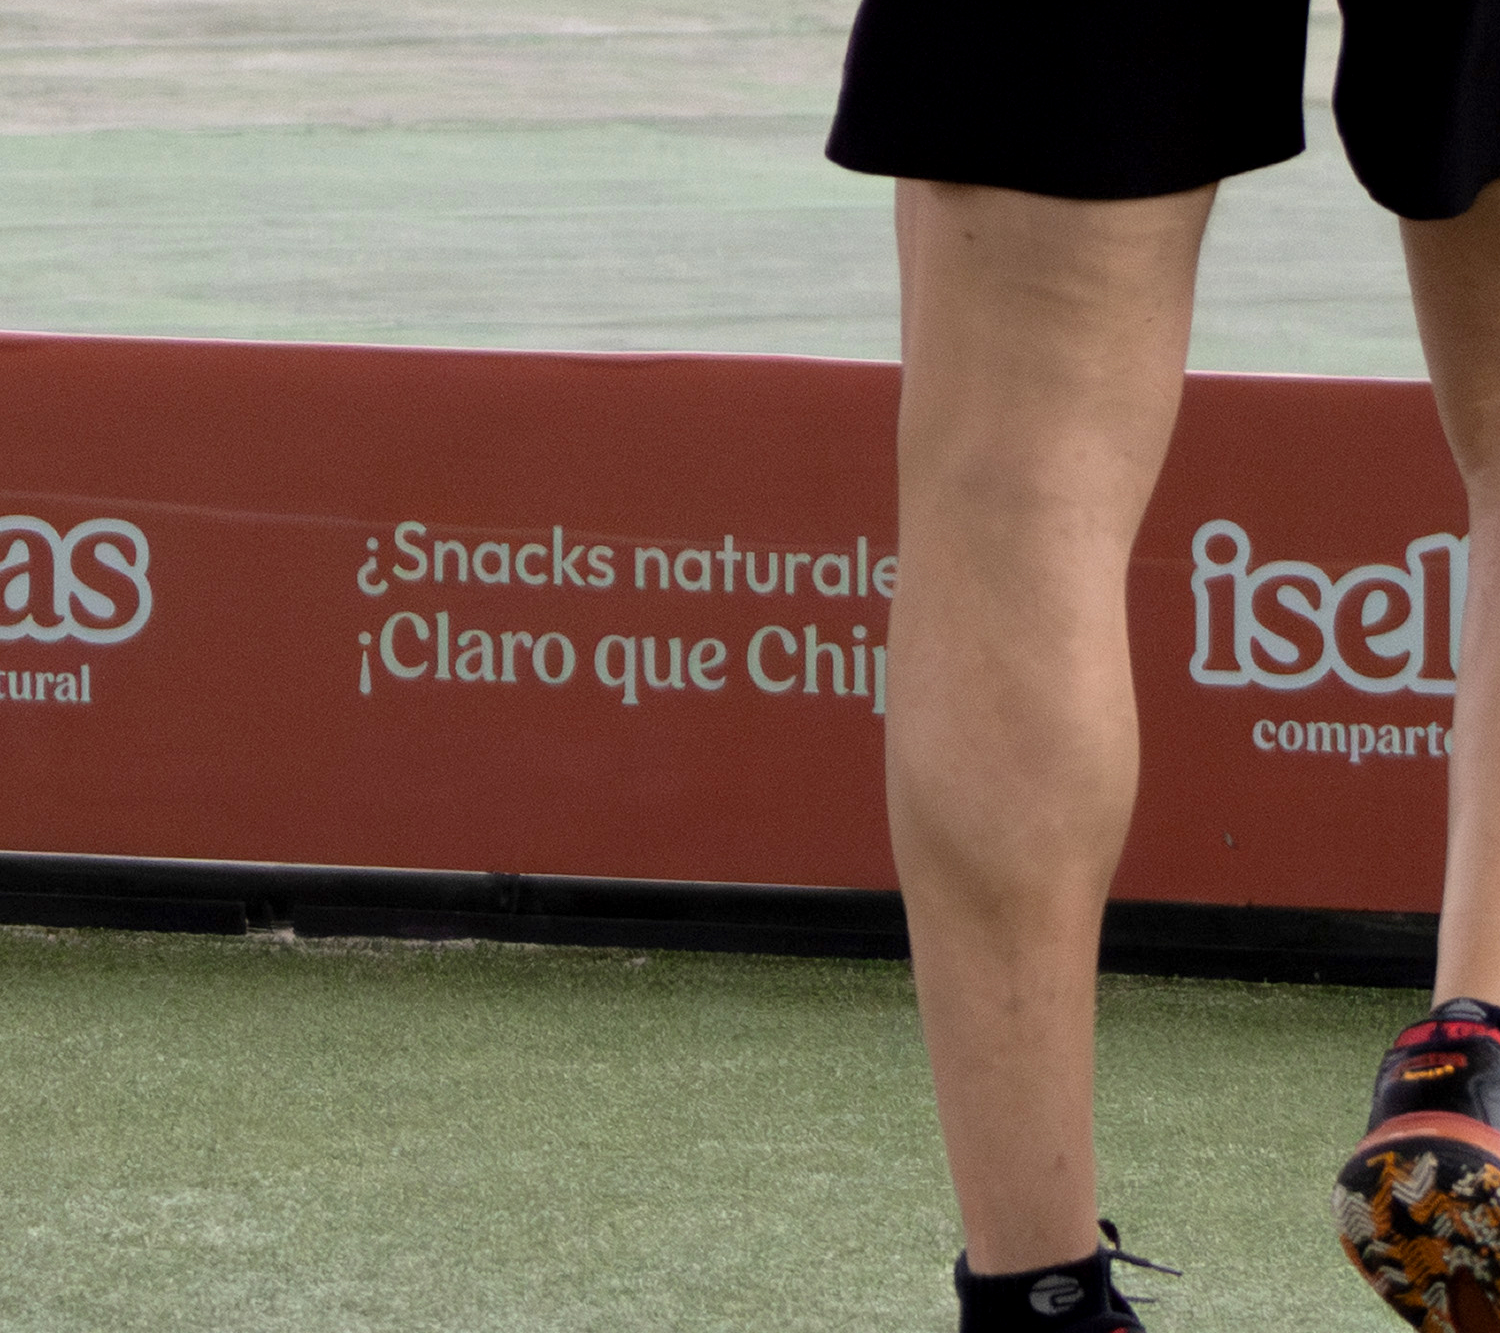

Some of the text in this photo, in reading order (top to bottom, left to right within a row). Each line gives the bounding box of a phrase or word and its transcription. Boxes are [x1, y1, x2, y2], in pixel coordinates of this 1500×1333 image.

[357, 521, 898, 600] ¿Snacks naturale
[359, 611, 576, 694] ¡Claro
[595, 635, 726, 705] que
